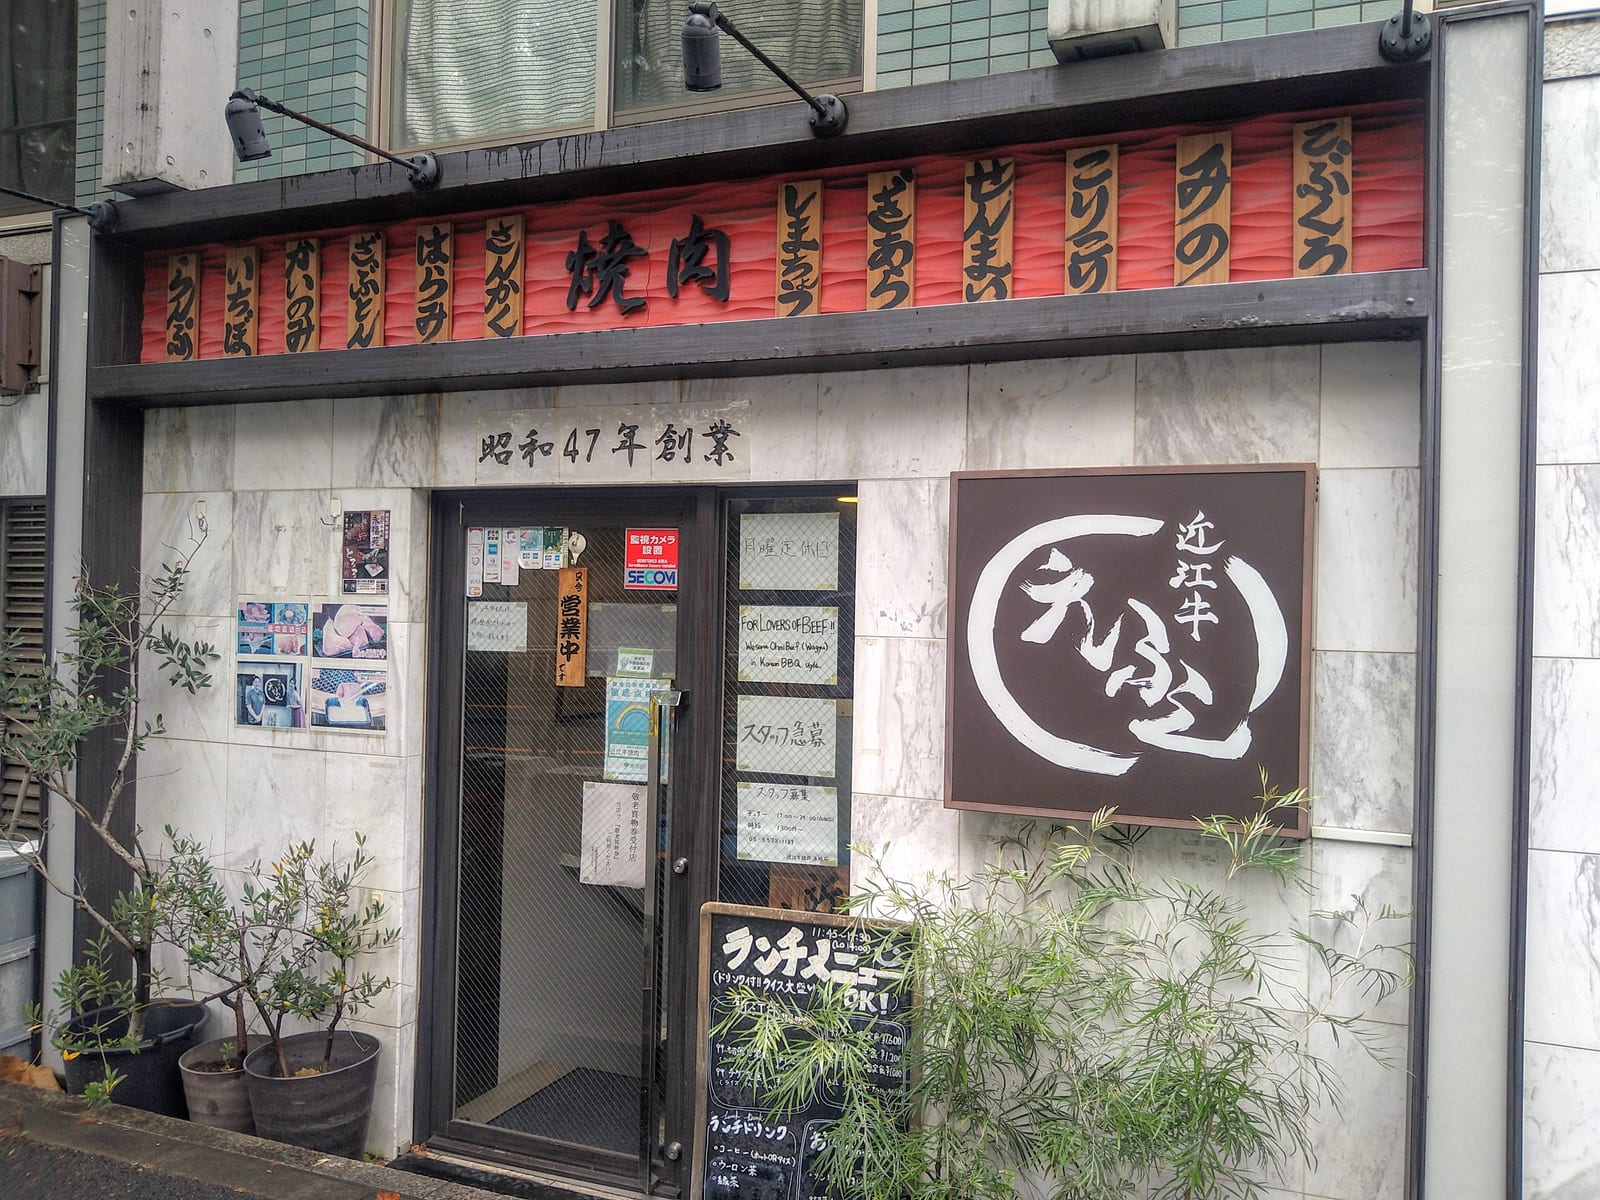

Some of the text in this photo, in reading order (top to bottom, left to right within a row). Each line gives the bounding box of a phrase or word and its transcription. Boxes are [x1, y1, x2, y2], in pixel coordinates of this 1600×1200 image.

[963, 158, 1013, 302] せんまい
[1175, 143, 1231, 286] みの
[224, 256, 254, 356] いちぼ
[286, 240, 315, 353] かいのみ
[347, 231, 381, 348] ざぶとん
[415, 226, 450, 343] はらみ
[485, 221, 520, 338] さんかく
[565, 214, 731, 316] 焼肉
[478, 419, 741, 468] 昭和47年創業
[628, 570, 676, 585] SECOM
[630, 534, 676, 545] 監視カメラ
[642, 545, 663, 555] 設置
[1168, 510, 1227, 641] 近江牛
[560, 594, 582, 663] 営業中
[741, 720, 826, 748] スタッフ急募
[722, 926, 905, 985] ランチメニュー
[709, 1115, 788, 1140] ランチドリンク
[718, 1159, 758, 1177] ウーロン茶
